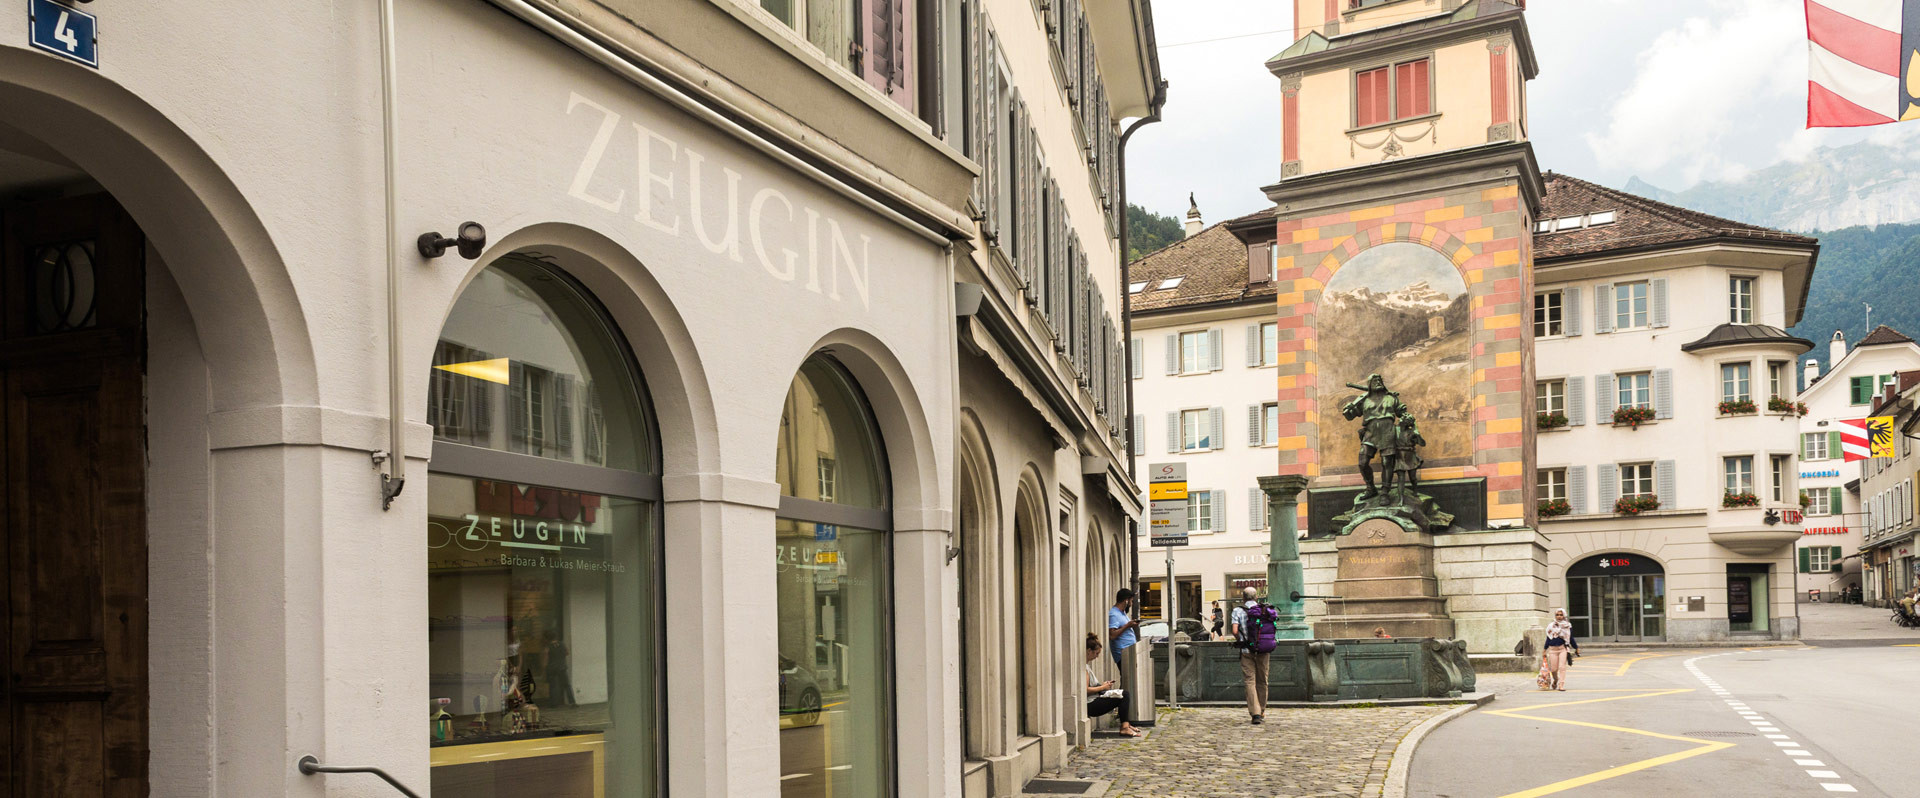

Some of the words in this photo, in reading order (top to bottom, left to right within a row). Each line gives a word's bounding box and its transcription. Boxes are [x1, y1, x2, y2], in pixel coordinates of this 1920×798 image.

[54, 11, 78, 52] 4
[566, 91, 871, 311] ZEUGIN
[1783, 510, 1804, 524] UBS
[466, 514, 586, 545] ZEUGIN
[1802, 526, 1849, 535] AIFFEISEN
[500, 553, 537, 568] Barbara
[539, 556, 547, 568] &
[550, 557, 574, 570] Lukas
[576, 559, 625, 573] Meier-Staub
[776, 545, 845, 566] ZEUGIN
[1611, 558, 1630, 567] UBS
[1236, 579, 1267, 588] FLORIST
